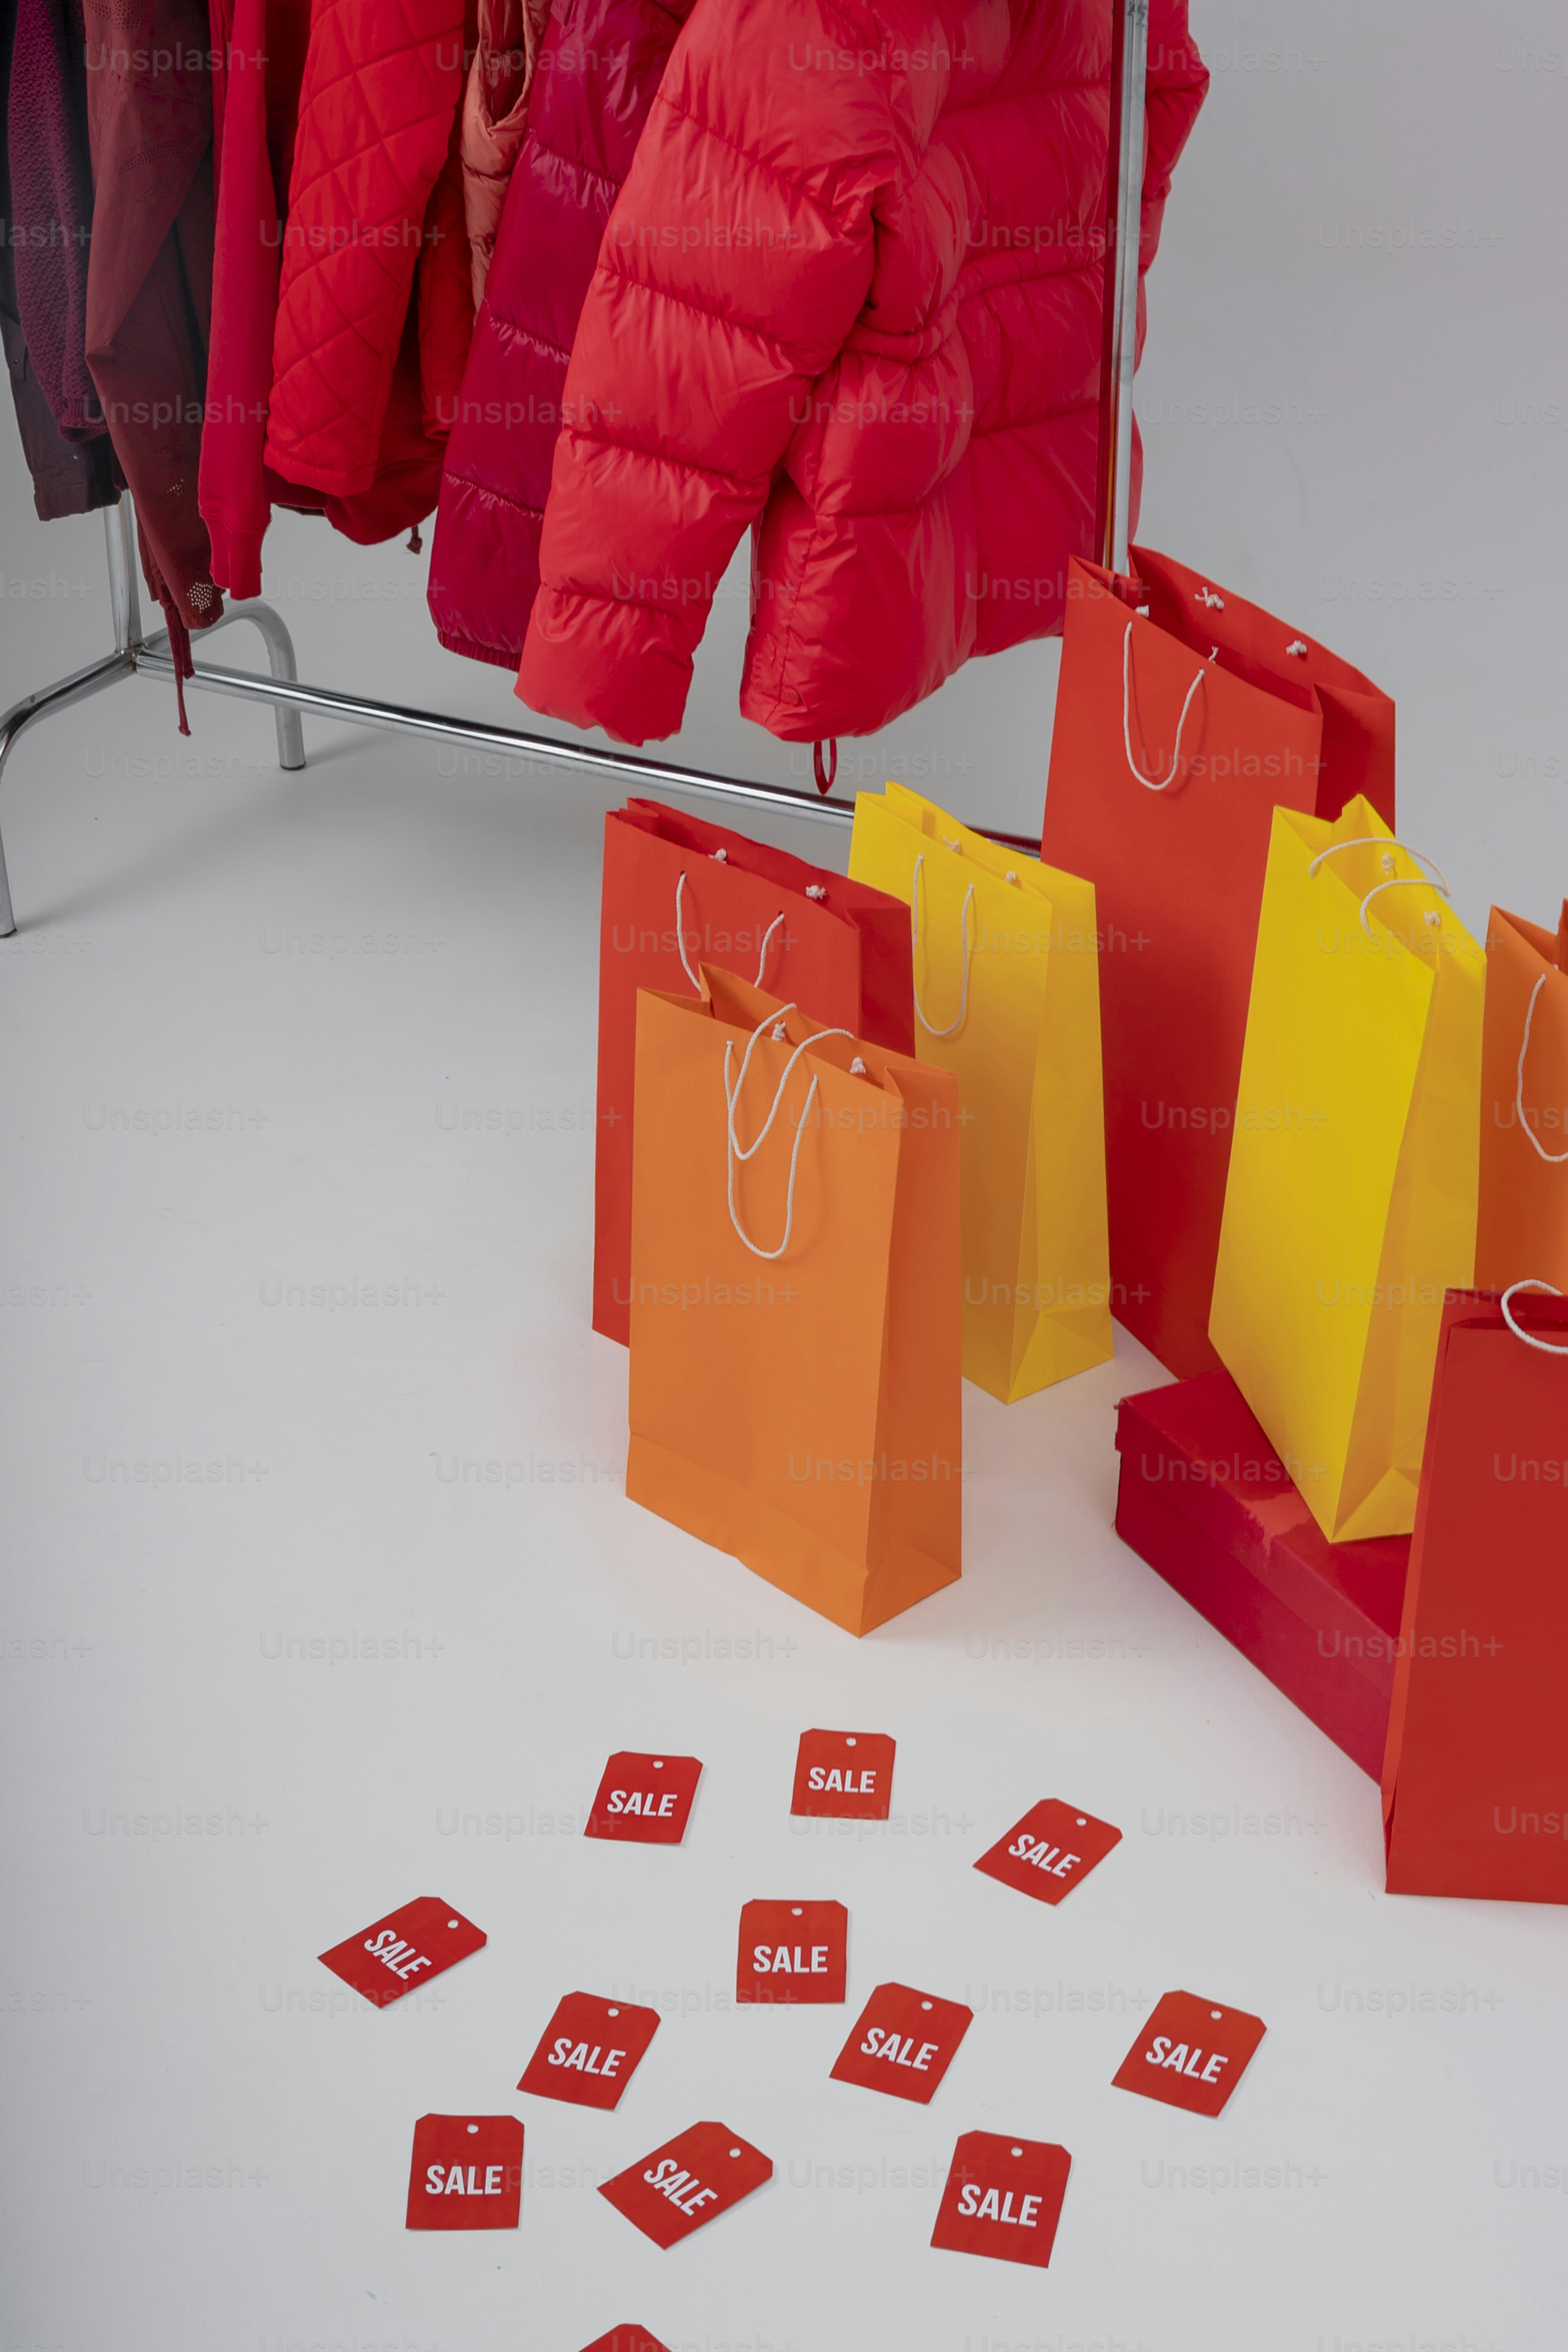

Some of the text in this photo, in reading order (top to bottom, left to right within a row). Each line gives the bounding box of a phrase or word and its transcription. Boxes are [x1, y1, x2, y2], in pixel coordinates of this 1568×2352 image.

[808, 1766, 877, 1794] SALE
[607, 1790, 678, 1817] SALE
[1008, 1833, 1081, 1878] SALE
[363, 1929, 432, 1980] SALE
[753, 1945, 829, 1973] SALE
[547, 2037, 627, 2077] SALE
[860, 2027, 939, 2071] SALE
[1145, 2036, 1229, 2084] SALE
[425, 2165, 503, 2195] SALE
[643, 2158, 718, 2216] SALE
[957, 2183, 1043, 2228] SALE
